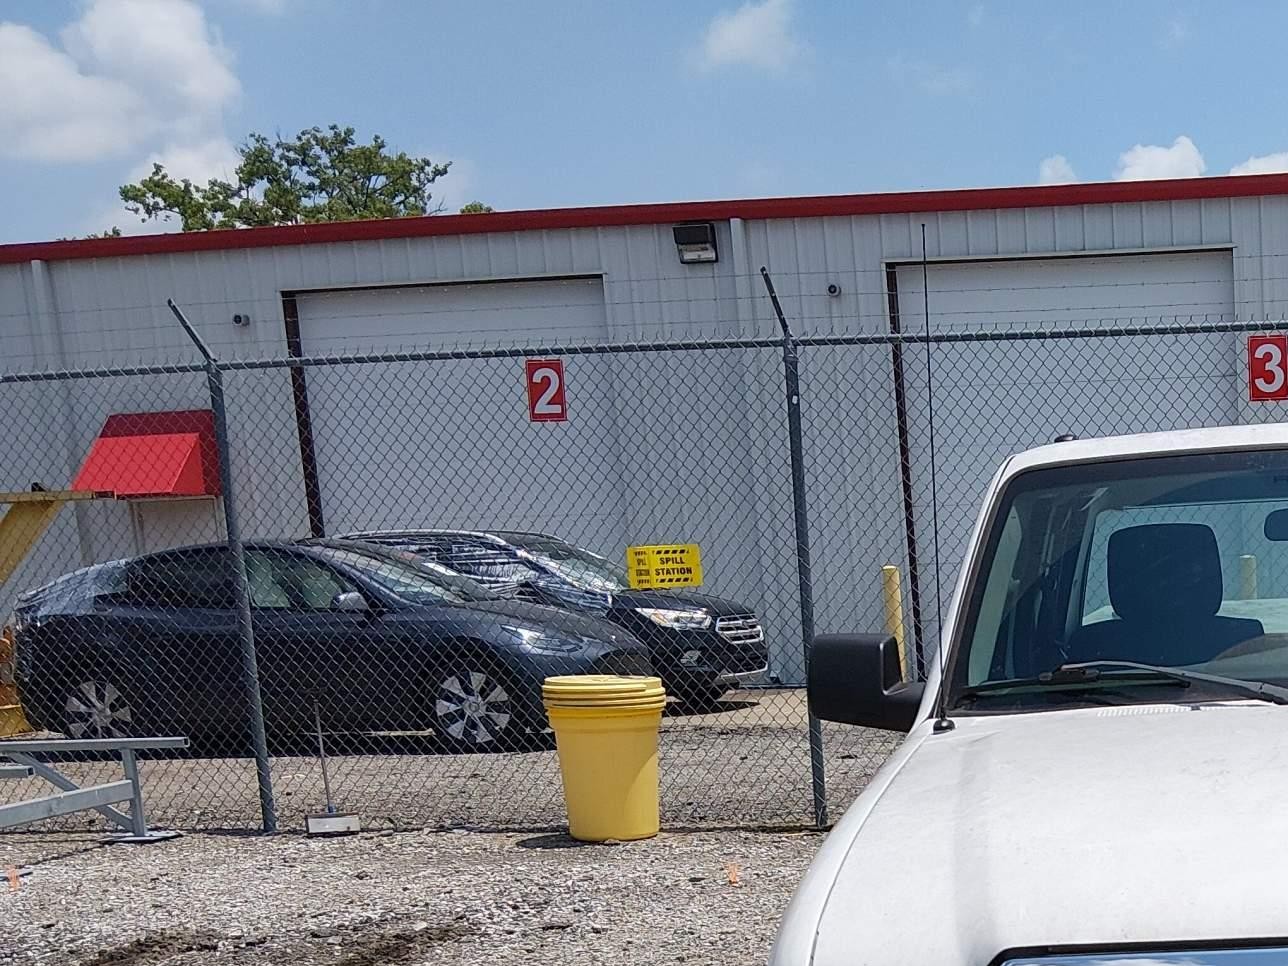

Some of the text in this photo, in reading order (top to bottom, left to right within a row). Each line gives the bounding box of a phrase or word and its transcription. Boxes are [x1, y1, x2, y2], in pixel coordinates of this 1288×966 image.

[1254, 343, 1285, 393] 3
[532, 367, 562, 414] 2
[654, 566, 693, 576] STATION
[659, 556, 686, 565] SPILL
